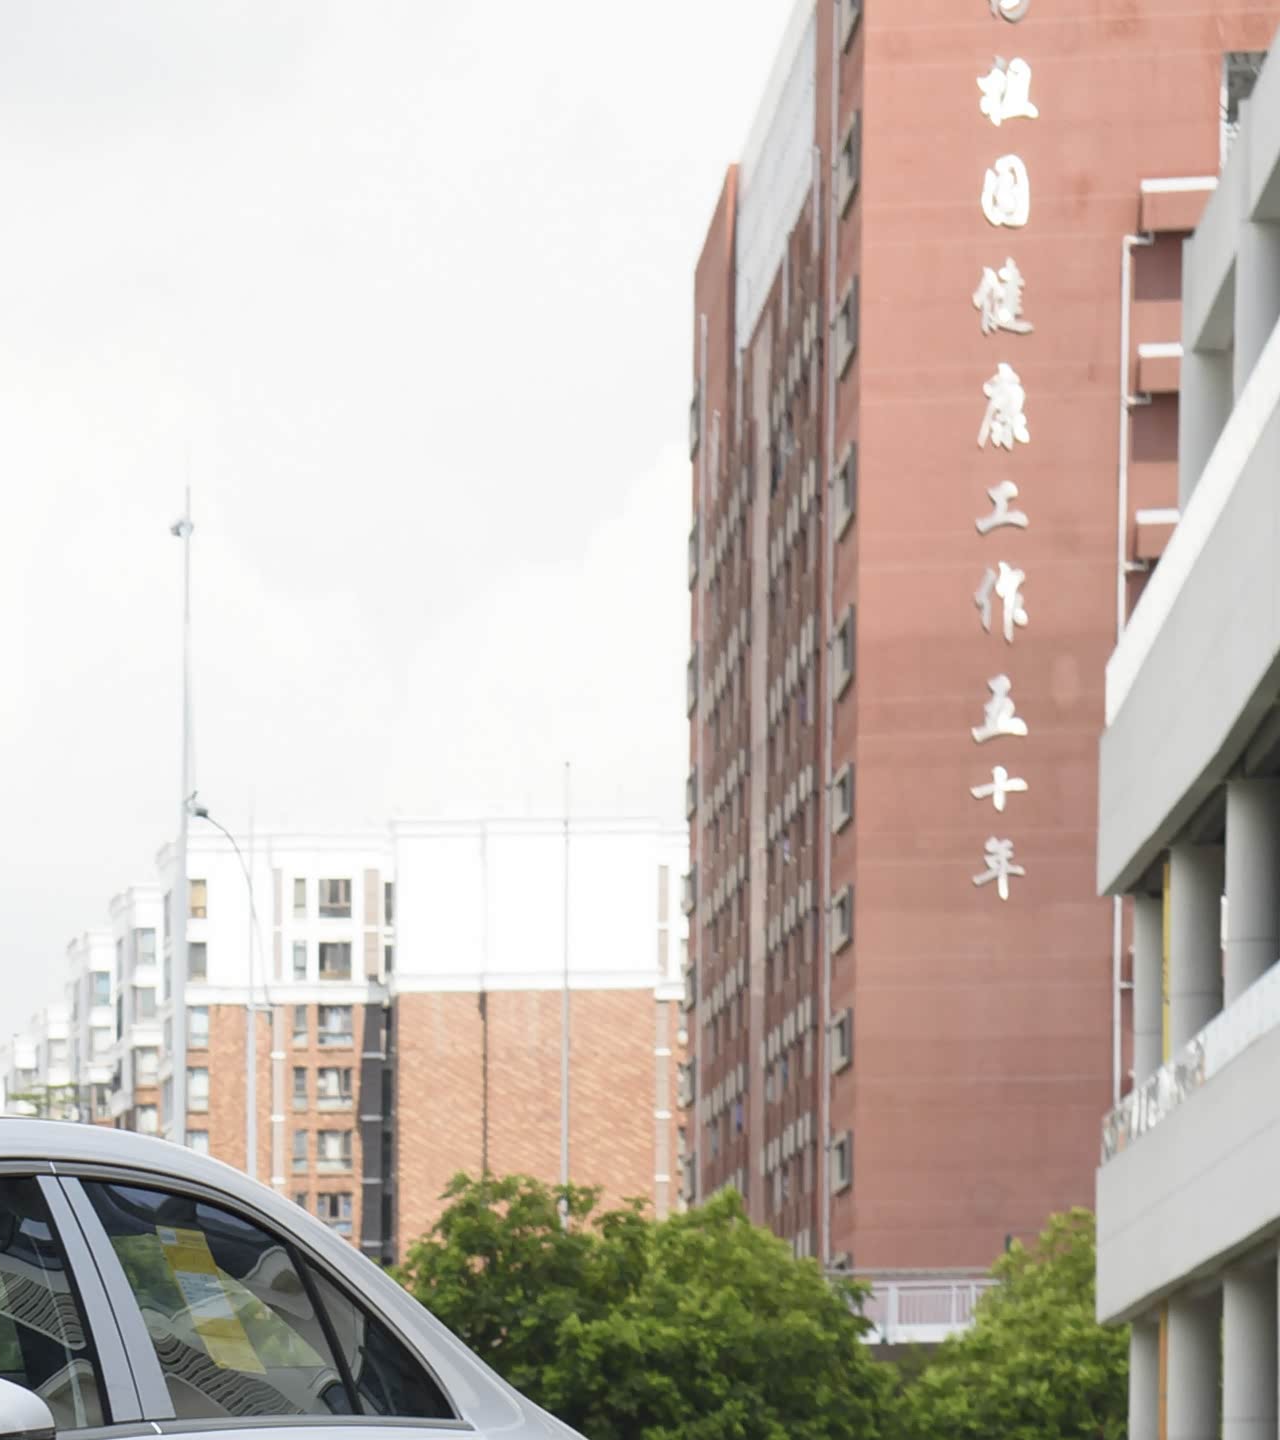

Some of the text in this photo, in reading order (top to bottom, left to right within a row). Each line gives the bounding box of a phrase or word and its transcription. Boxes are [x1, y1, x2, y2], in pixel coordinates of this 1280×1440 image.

[971, 0, 1039, 900] 祖国健康工作五十年
